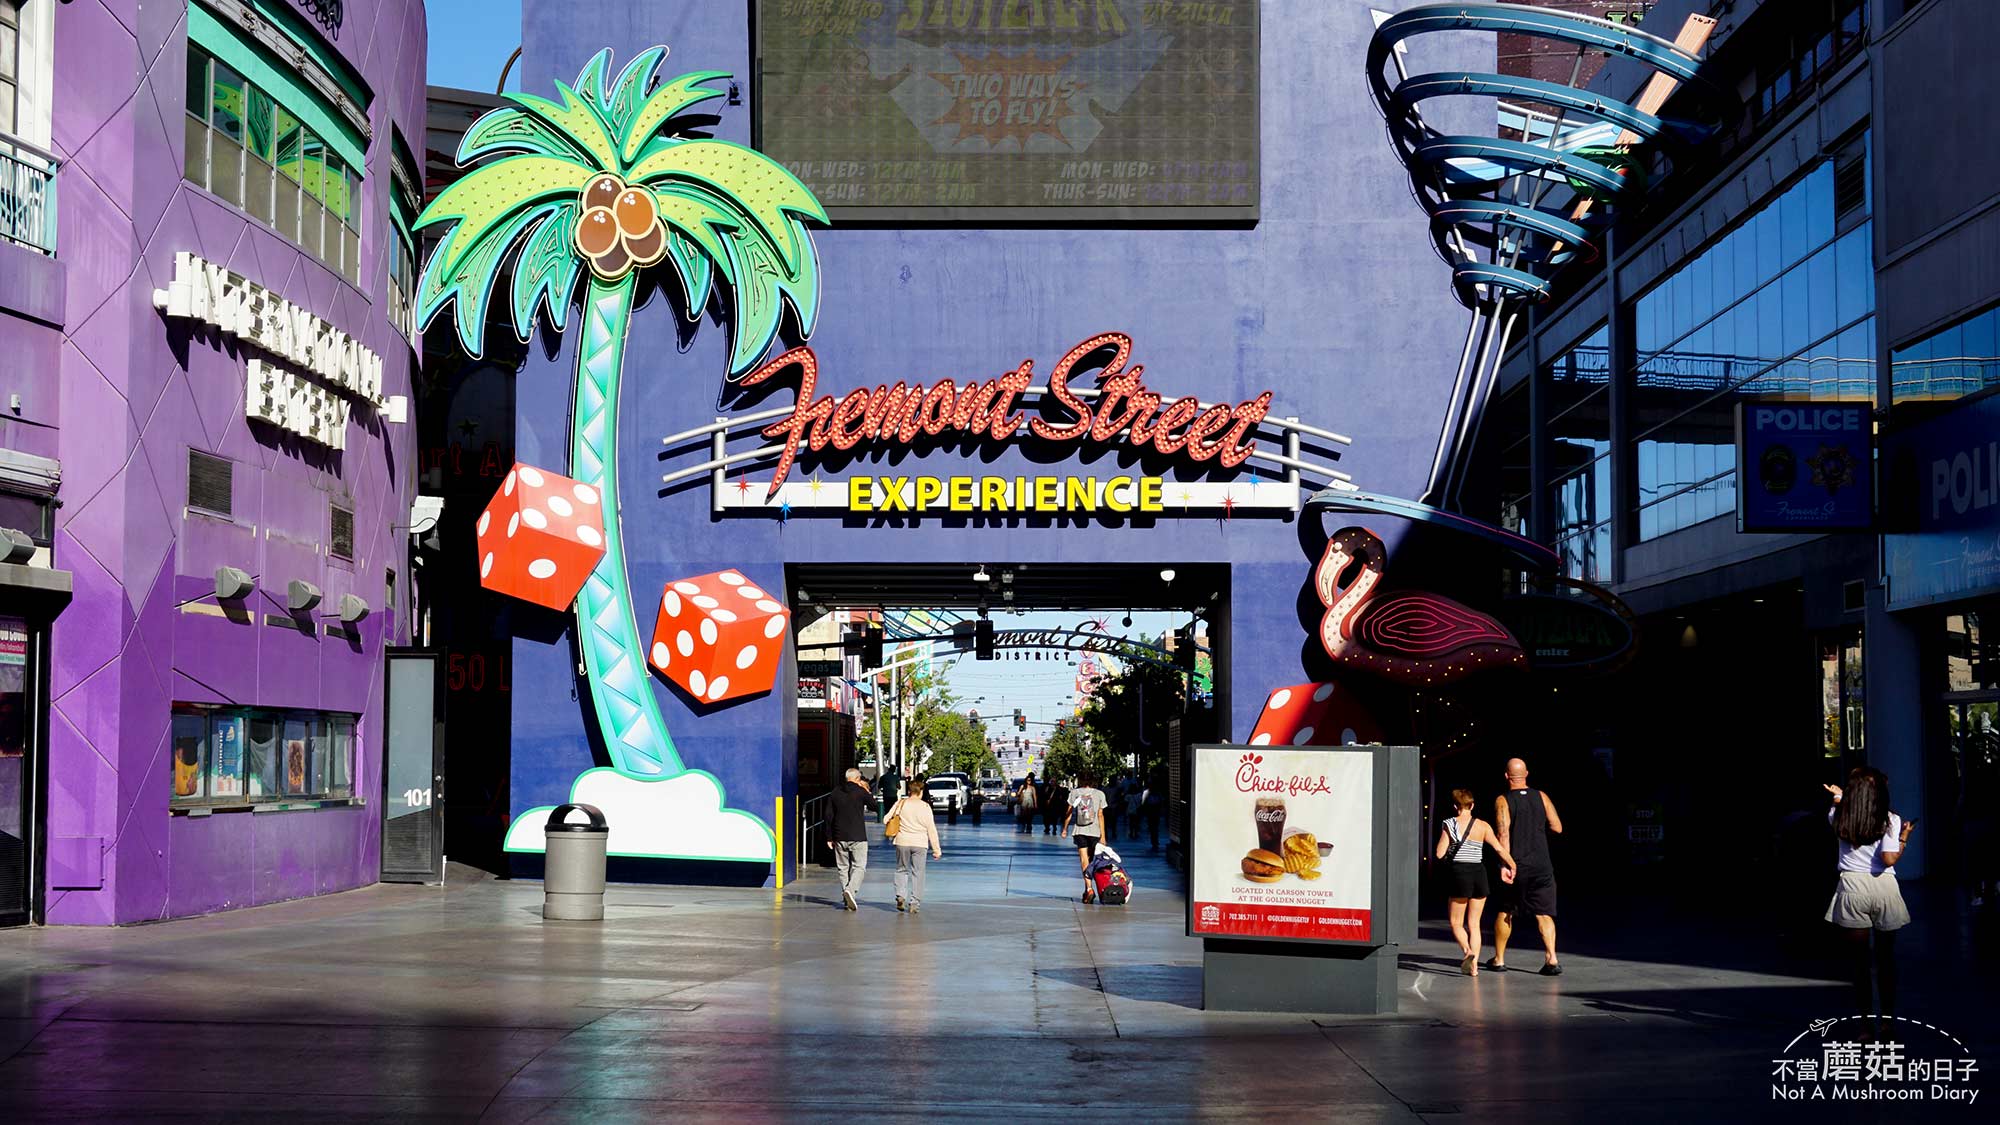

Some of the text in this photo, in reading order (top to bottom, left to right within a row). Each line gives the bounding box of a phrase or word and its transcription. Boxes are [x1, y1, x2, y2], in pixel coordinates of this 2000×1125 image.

[951, 72, 1077, 99] TWO WAYS
[970, 98, 1059, 126] TO FLY!
[783, 161, 866, 178] ON-WED:
[1060, 161, 1156, 178] MON-WED:
[1043, 184, 1137, 200] THUR-SUN:
[740, 331, 1275, 502] Fremont Street
[1755, 409, 1859, 431] POLICE
[1931, 440, 2000, 521] POLI
[848, 476, 1165, 512] EXPERIENCE
[1065, 620, 1128, 651] East
[995, 651, 1070, 661] DISTRICT
[1235, 760, 1331, 797] Chick-fil-A
[403, 788, 431, 807] 101
[1265, 896, 1293, 904] GOLDEN
[1295, 897, 1326, 905] NUGGET
[1276, 888, 1305, 896] CARSON
